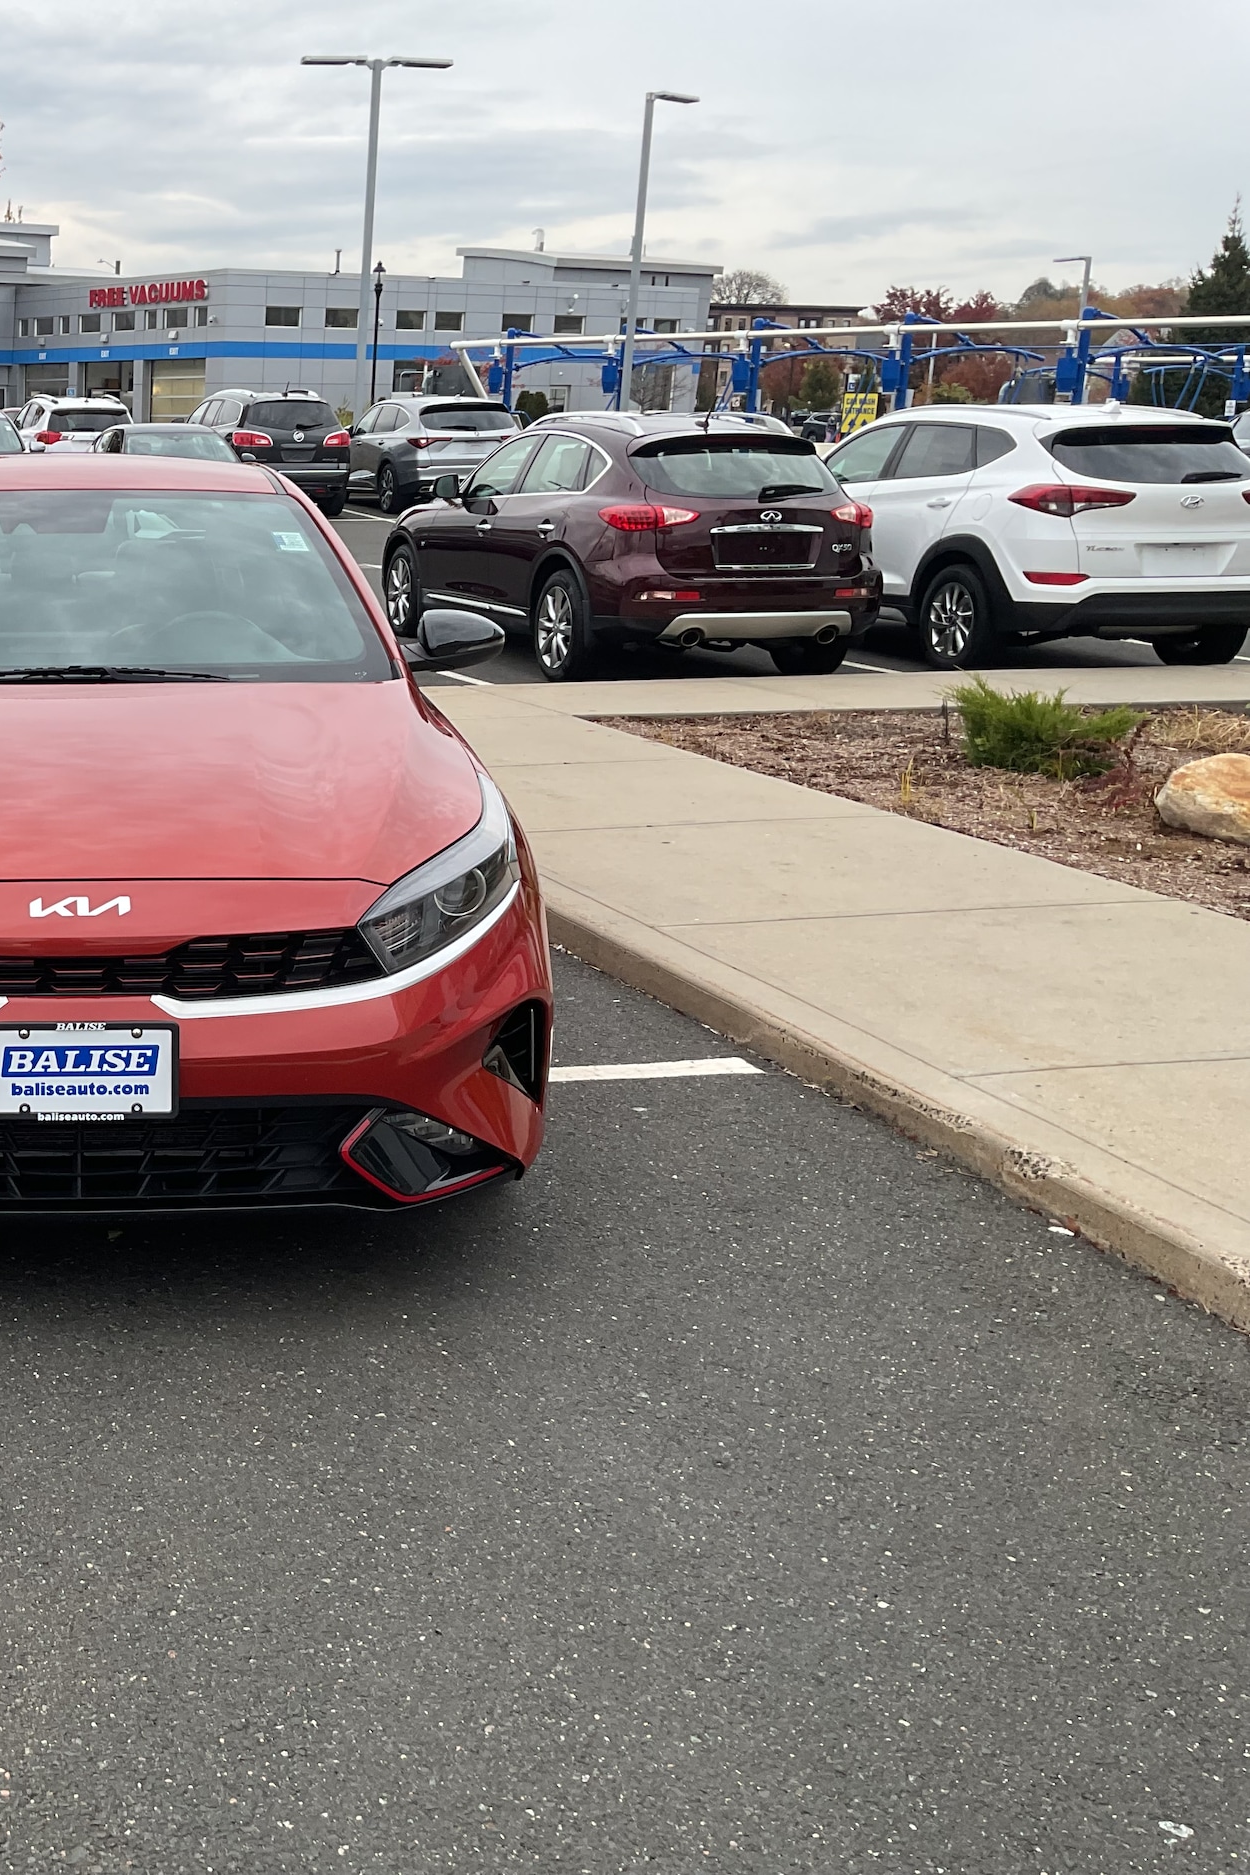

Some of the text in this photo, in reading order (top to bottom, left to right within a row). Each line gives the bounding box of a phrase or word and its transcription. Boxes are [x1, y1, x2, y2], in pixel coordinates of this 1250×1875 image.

[89, 279, 209, 308] FREE VACUUMS
[29, 896, 131, 918] KIA
[56, 1022, 106, 1031] BALISE
[7, 1049, 153, 1073] BALISE
[11, 1082, 149, 1096] baliseauto.com
[37, 1112, 125, 1121] baliseauto.com
